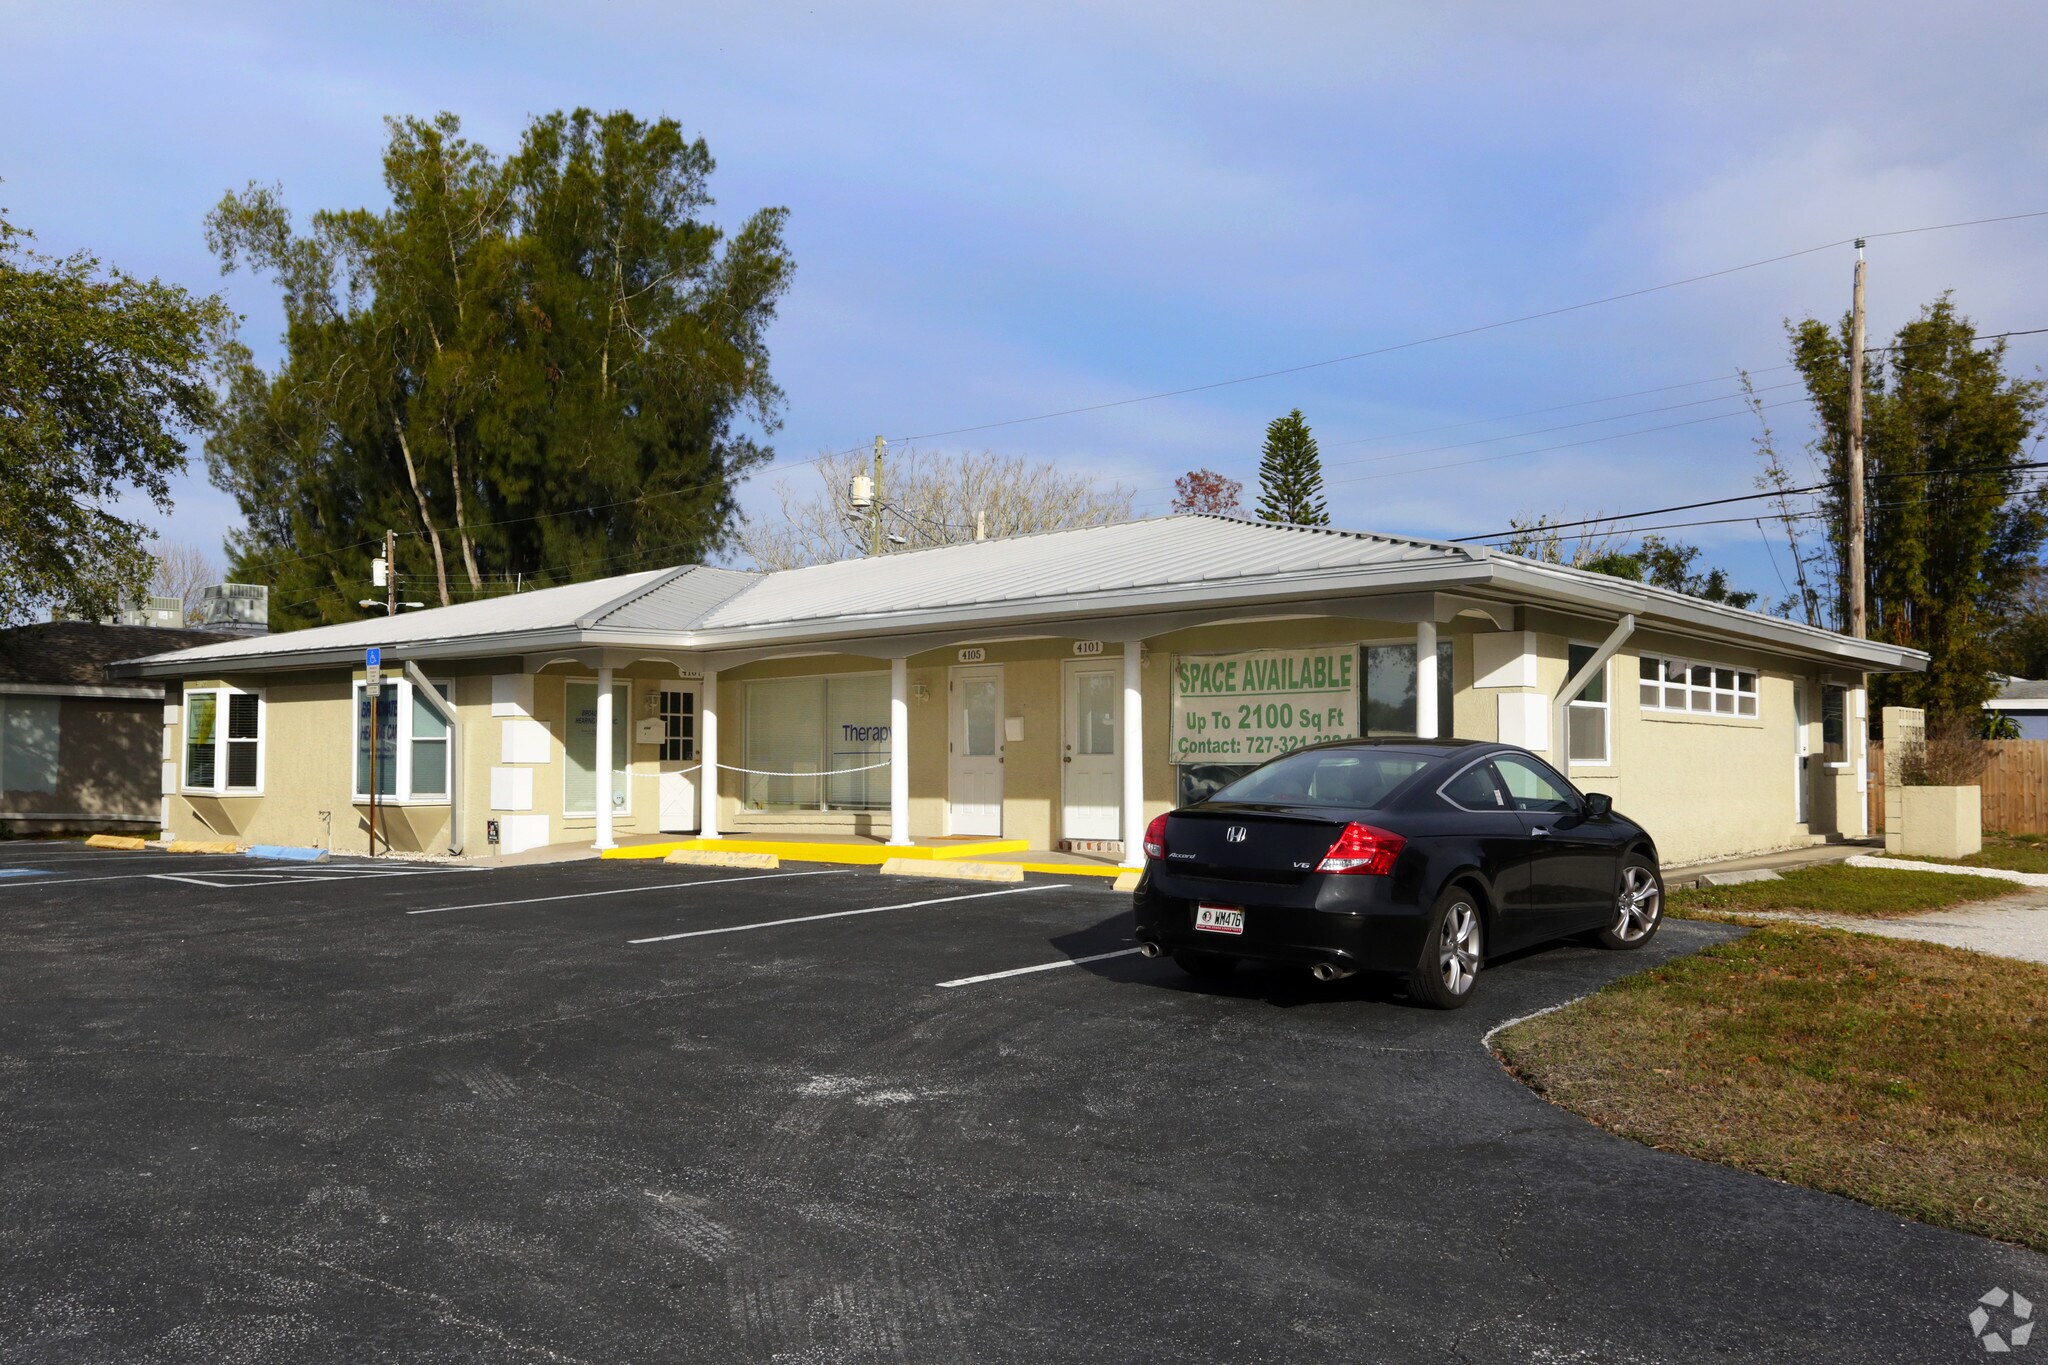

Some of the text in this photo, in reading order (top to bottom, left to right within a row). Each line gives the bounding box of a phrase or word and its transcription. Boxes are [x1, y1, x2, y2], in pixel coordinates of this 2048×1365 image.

[1077, 641, 1100, 653] 4101
[962, 649, 981, 660] 4105
[1180, 655, 1352, 693] SPACE AVAILABLE
[1186, 703, 1344, 733] Up To 2100 Sq Ft
[1178, 737, 1241, 754] Contact:
[1293, 861, 1311, 869] V6
